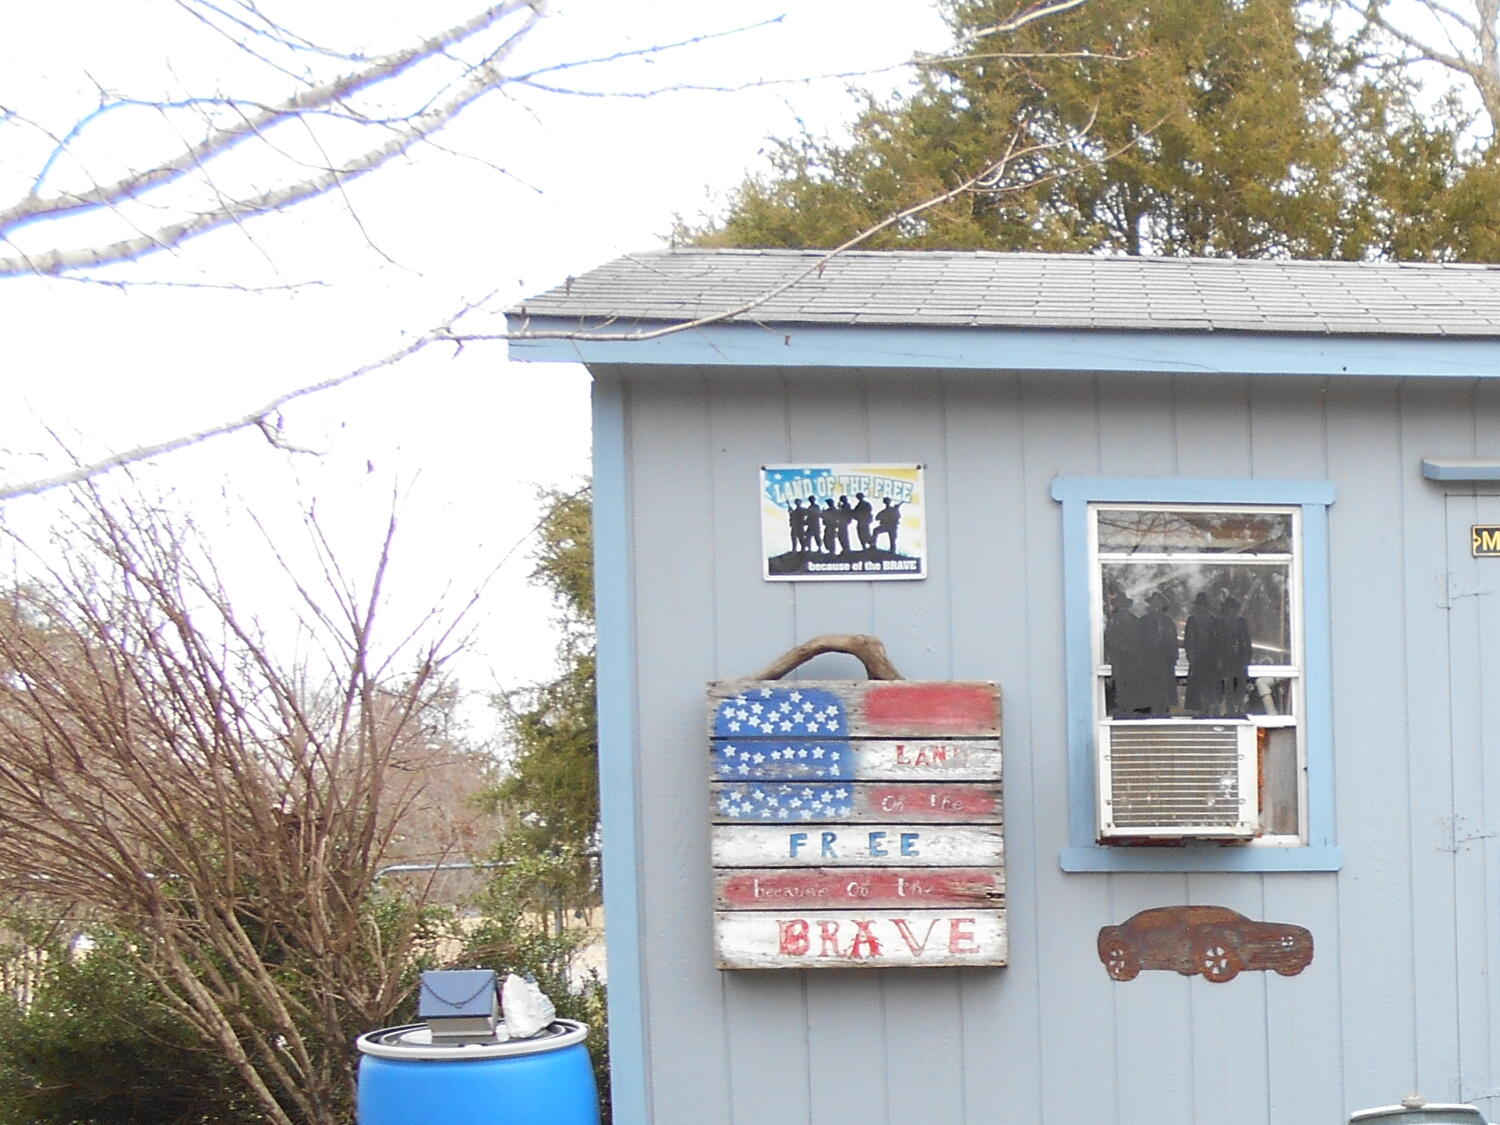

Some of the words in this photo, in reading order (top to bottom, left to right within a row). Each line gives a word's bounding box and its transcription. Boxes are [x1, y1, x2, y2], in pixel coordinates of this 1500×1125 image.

[775, 478, 812, 502] LAND
[817, 475, 836, 497] OF
[839, 475, 870, 498] THE
[873, 477, 914, 503] FREE
[808, 561, 850, 571] because
[852, 561, 863, 571] of
[864, 560, 881, 571] the
[882, 560, 917, 571] BRAVE
[789, 832, 921, 858] FREE
[777, 918, 982, 958] BRAVE
